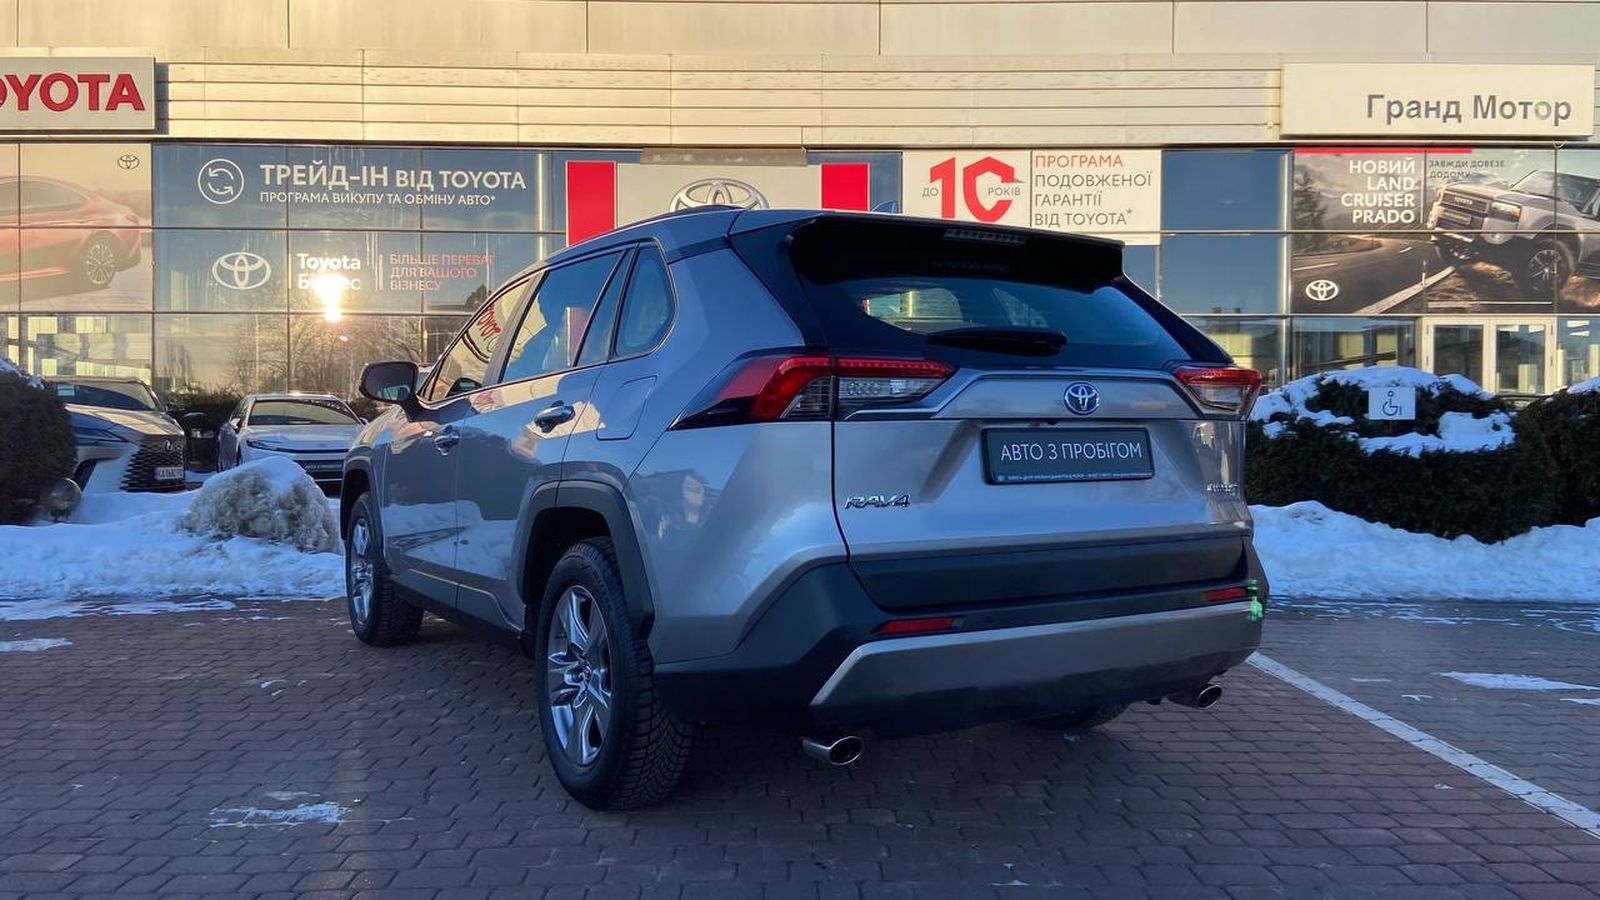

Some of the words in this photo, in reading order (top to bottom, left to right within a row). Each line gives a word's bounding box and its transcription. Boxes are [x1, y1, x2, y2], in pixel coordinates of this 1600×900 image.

[0, 73, 145, 111] YOTA
[1367, 94, 1462, 125] Гранд
[1473, 95, 1571, 126] Мотор
[1035, 154, 1124, 168] ПРОГРАМА
[1349, 157, 1416, 174] НОВИЙ
[260, 160, 388, 190] ТРЕЙД-ІН
[395, 170, 434, 191] ВІД
[438, 170, 527, 189] TOYOTA
[1035, 171, 1153, 189] ПОДОВЖЕНОЇ
[1367, 176, 1416, 191] LAND
[260, 192, 330, 203] ПРОГРАМА
[333, 193, 384, 205] ВИКУПУ
[387, 193, 402, 204] ТА
[404, 194, 456, 206] ОБМІНУ
[922, 187, 939, 198] ДО
[988, 187, 1021, 197] РОКІВ
[1035, 191, 1103, 206] ГАРАНТІЇ
[1341, 193, 1416, 207] CRUISER
[1035, 213, 1060, 228] ВІД
[1352, 209, 1416, 224] PRADO
[297, 253, 361, 272] Toyota
[390, 254, 438, 265] БІЛЬШЕ
[442, 254, 494, 266] ПЕРЕВАГ
[390, 267, 417, 279] ДЛЯ
[420, 267, 476, 278] ВАШОГО
[390, 279, 440, 291] БІЗНЕСУ
[1001, 443, 1043, 461] АВТО
[1062, 442, 1142, 460] ПРОБІГОМ
[844, 494, 910, 509] RAV4
